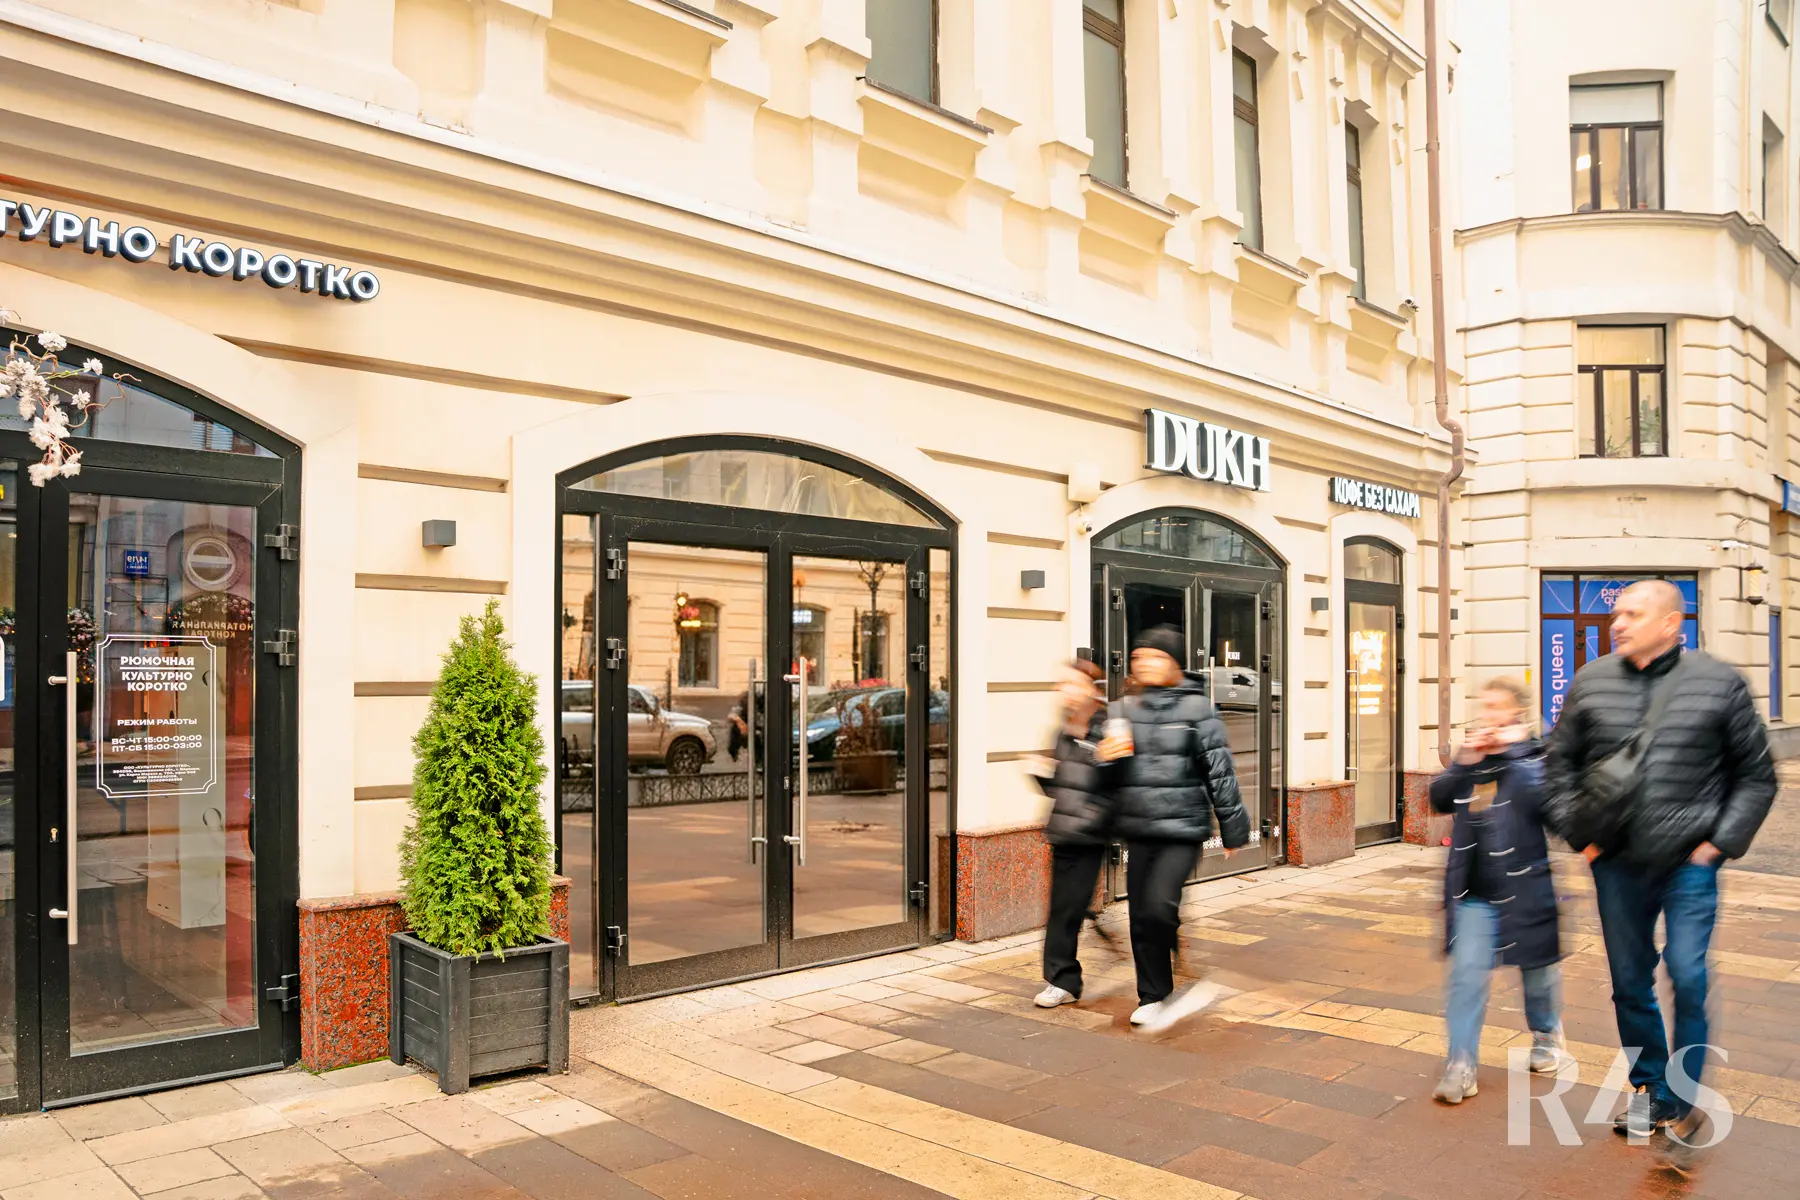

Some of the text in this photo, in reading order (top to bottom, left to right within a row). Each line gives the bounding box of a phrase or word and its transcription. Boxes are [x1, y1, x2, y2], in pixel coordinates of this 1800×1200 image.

[169, 233, 380, 302] КОРОТКО
[1146, 408, 1271, 493] DUKH
[1333, 476, 1420, 518] КОФЕ БЕЗ САХАРА
[120, 656, 195, 666] РЮМОЧНАЯ
[1551, 633, 1568, 691] queen
[121, 671, 193, 681] КУЛЬТУРНО
[127, 682, 188, 692] КОРОТКО
[143, 734, 202, 743] 15:00-00:00
[143, 741, 202, 751] 15:00-03:00
